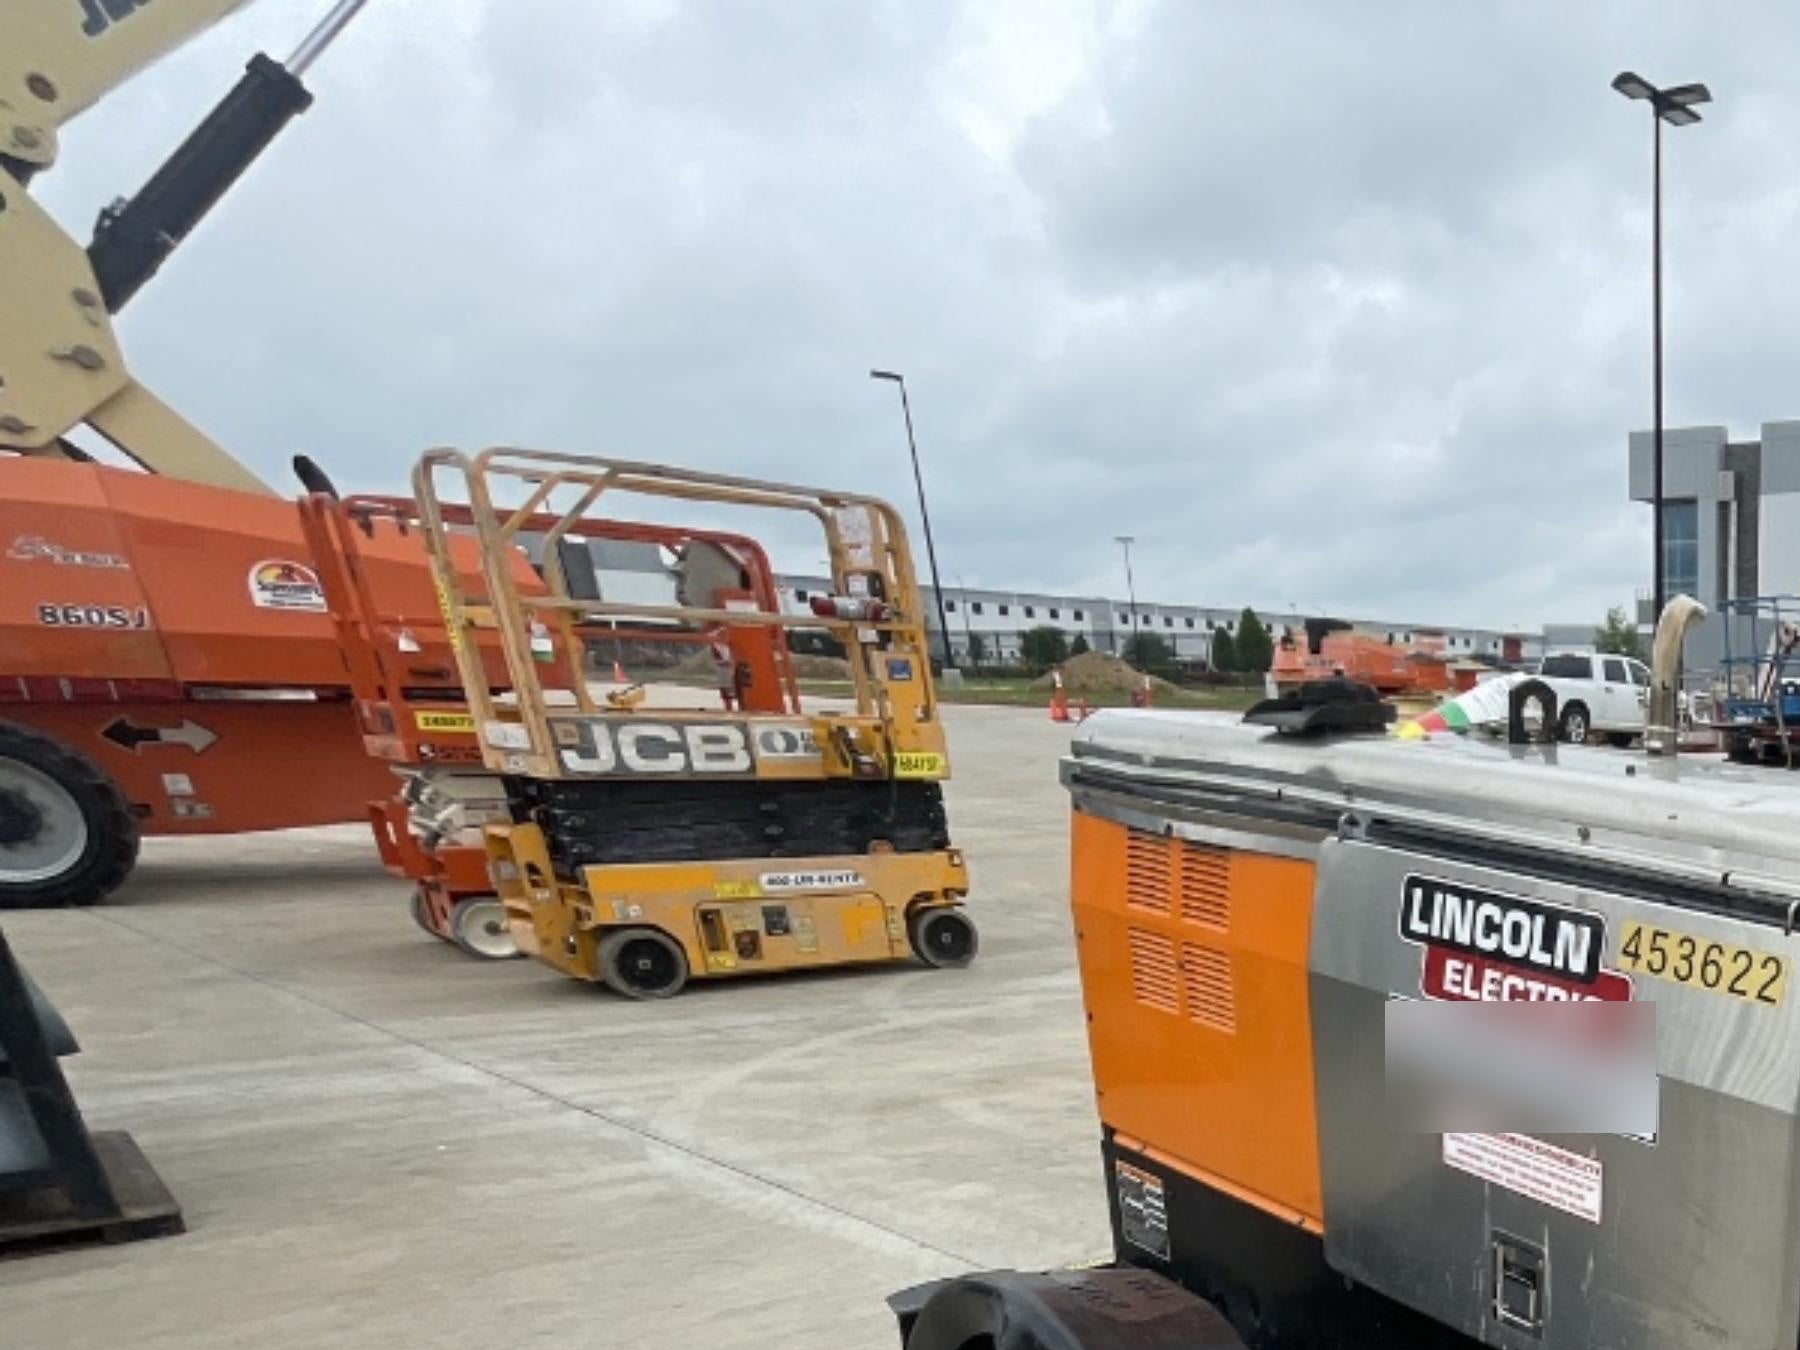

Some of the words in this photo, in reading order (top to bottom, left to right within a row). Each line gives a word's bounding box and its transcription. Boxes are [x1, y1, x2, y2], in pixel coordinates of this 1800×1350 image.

[38, 603, 148, 630] 860SJ
[561, 725, 751, 773] JCB
[1409, 887, 1592, 975] LINCOLN
[1442, 959, 1603, 1002] ELECT
[1622, 926, 1783, 1004] 453622
